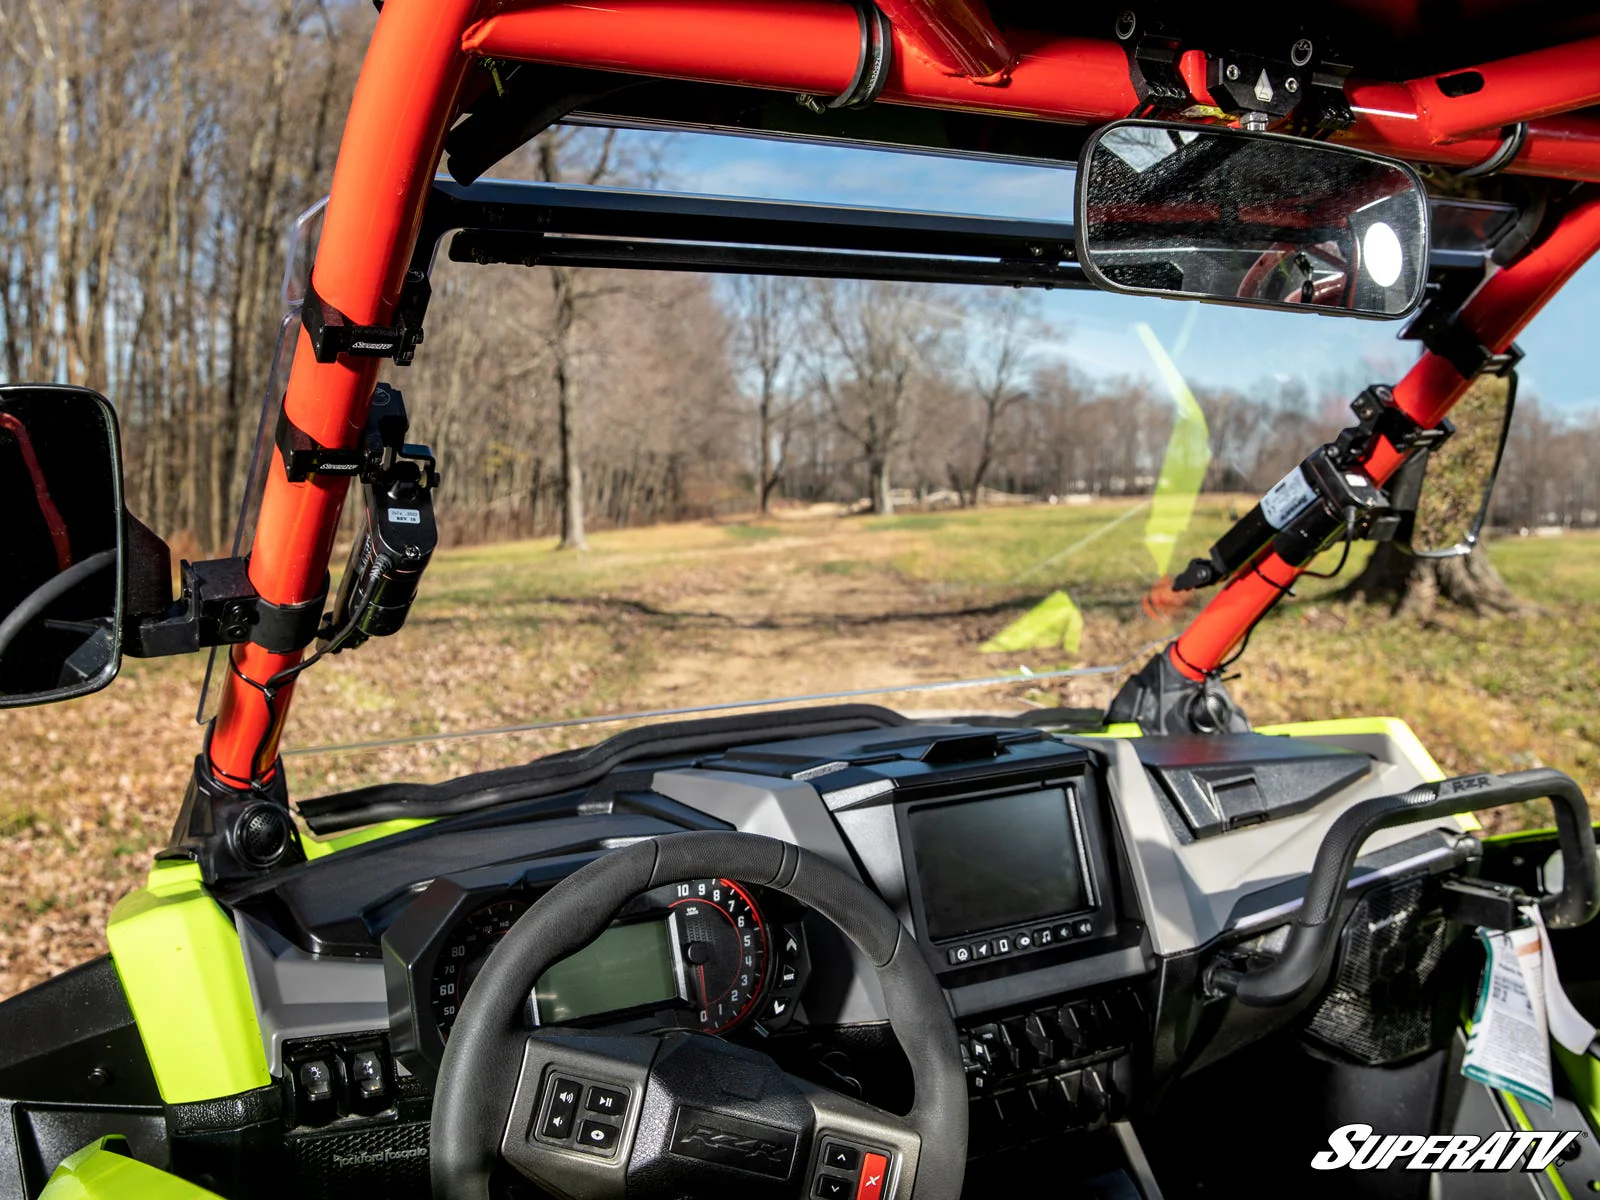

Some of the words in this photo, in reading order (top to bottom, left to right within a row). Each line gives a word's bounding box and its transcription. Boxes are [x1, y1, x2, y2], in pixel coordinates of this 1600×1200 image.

[1452, 776, 1491, 793] RZR
[677, 884, 689, 897] 10
[698, 884, 706, 896] 9
[713, 889, 720, 902] 8
[728, 900, 735, 912] 7
[737, 915, 745, 928] 6
[743, 934, 751, 947] 5
[451, 945, 465, 957] 80
[745, 955, 752, 967] 4
[444, 965, 455, 975] 70
[741, 974, 748, 986] 3
[440, 983, 455, 996] 60
[731, 990, 739, 1002] 2
[443, 1006, 455, 1016] 50
[718, 1003, 722, 1015] 1
[700, 1010, 708, 1022] 0
